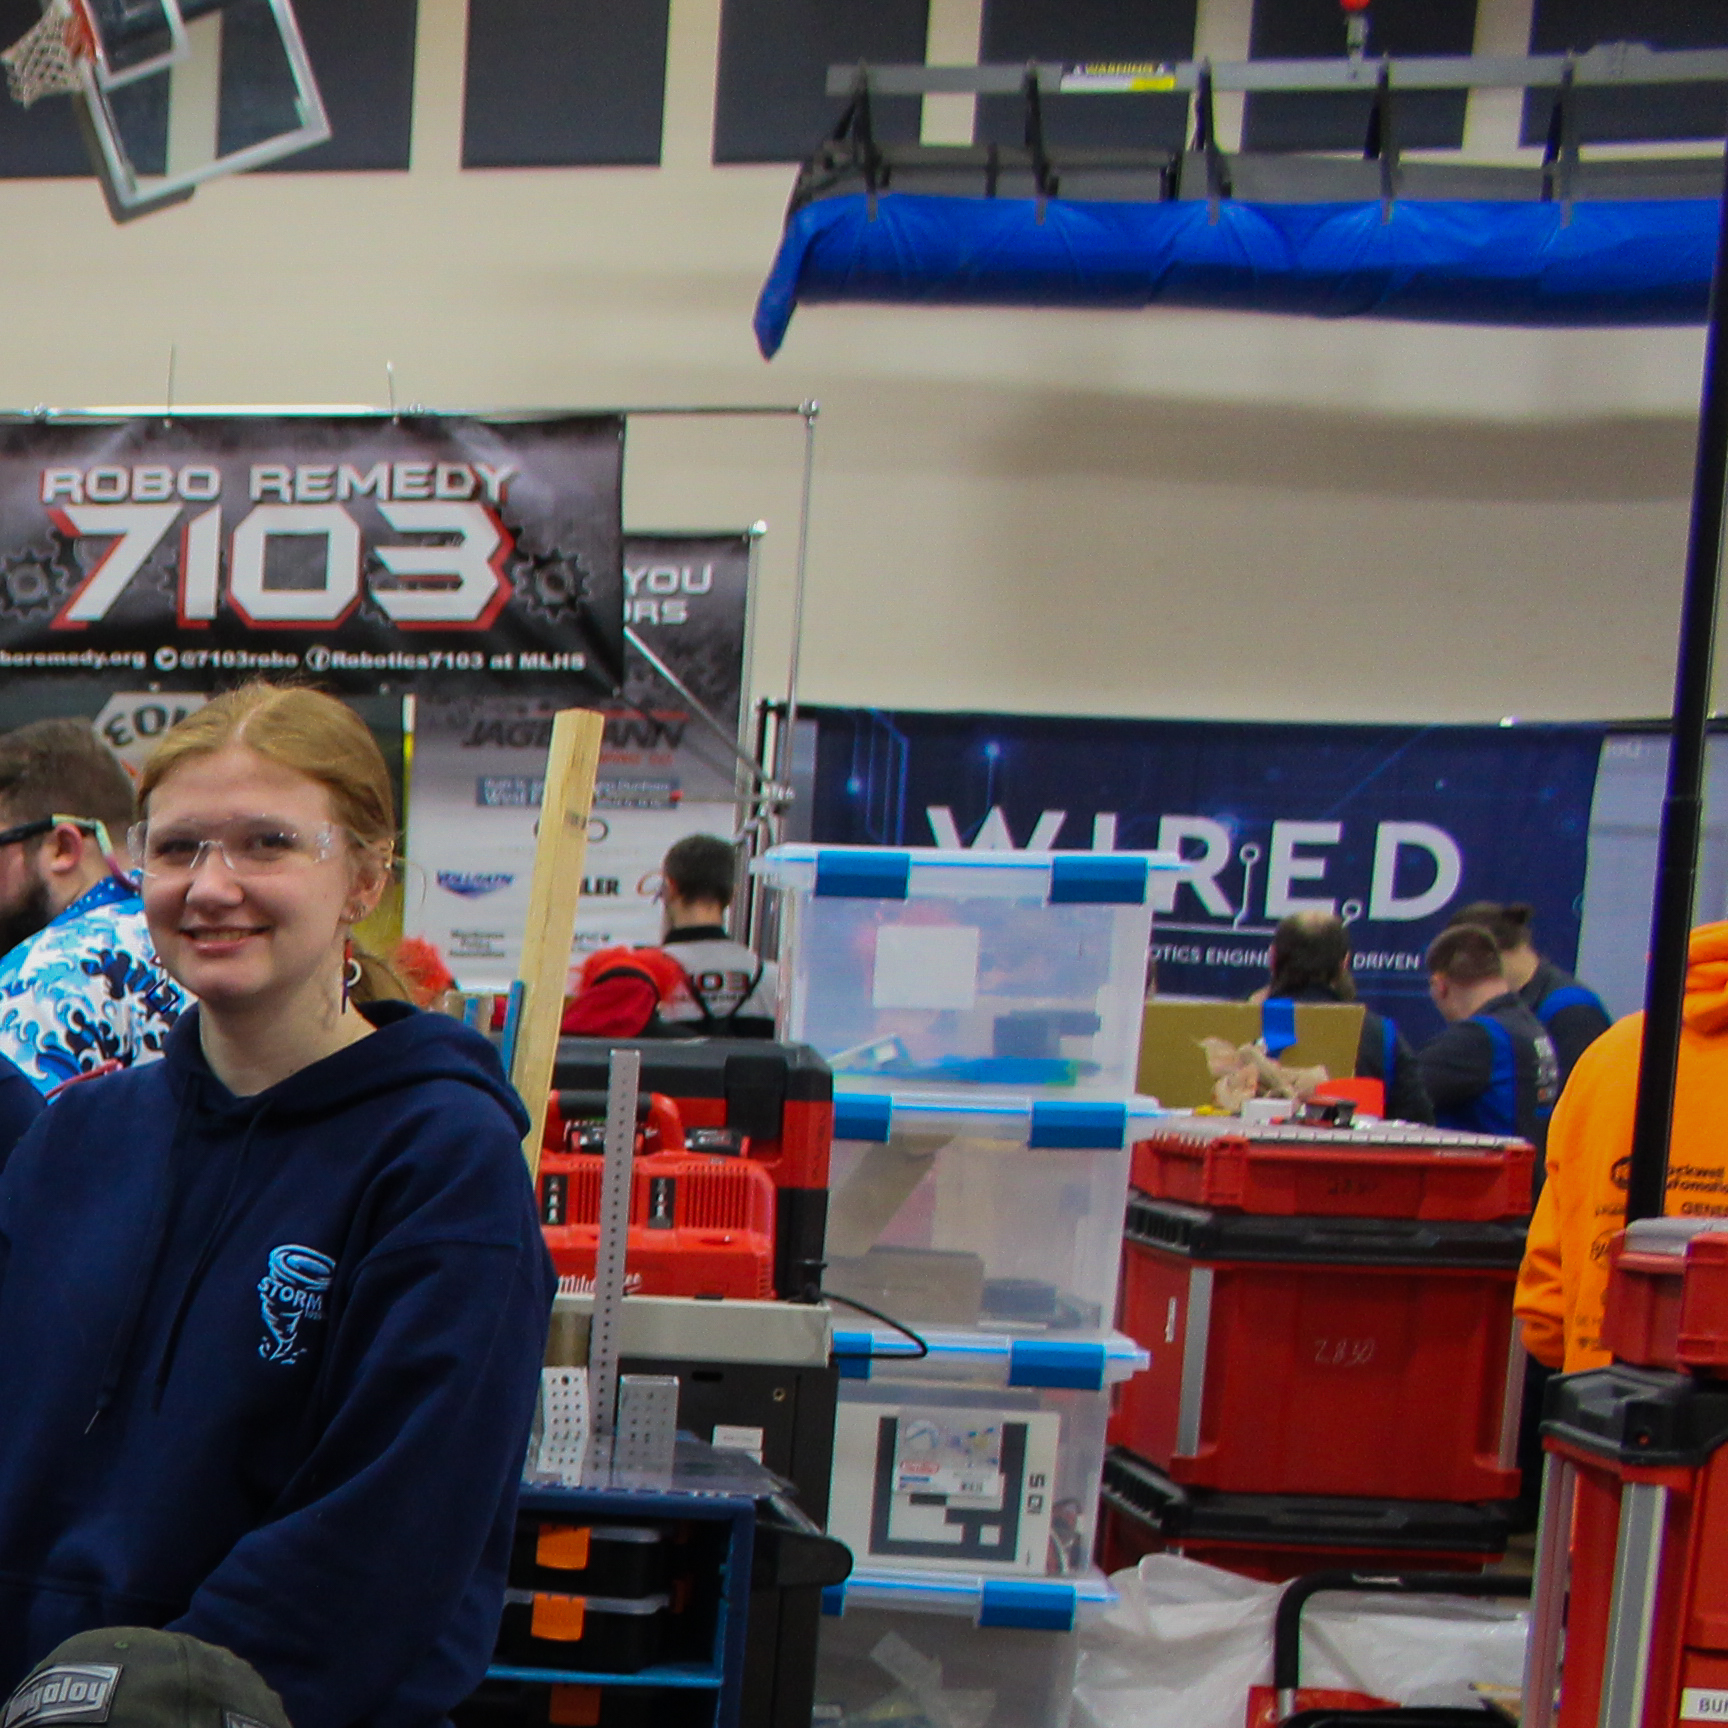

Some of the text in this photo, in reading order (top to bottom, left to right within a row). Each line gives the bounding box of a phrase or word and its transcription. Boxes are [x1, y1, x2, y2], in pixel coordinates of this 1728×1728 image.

[43, 461, 519, 502] ROBO REMEDY
[49, 500, 515, 631] 7103
[623, 563, 713, 596] YOU
[1149, 944, 1200, 964] OTICS
[1352, 951, 1420, 971] DRIVEN
[257, 1276, 323, 1312] STORM
